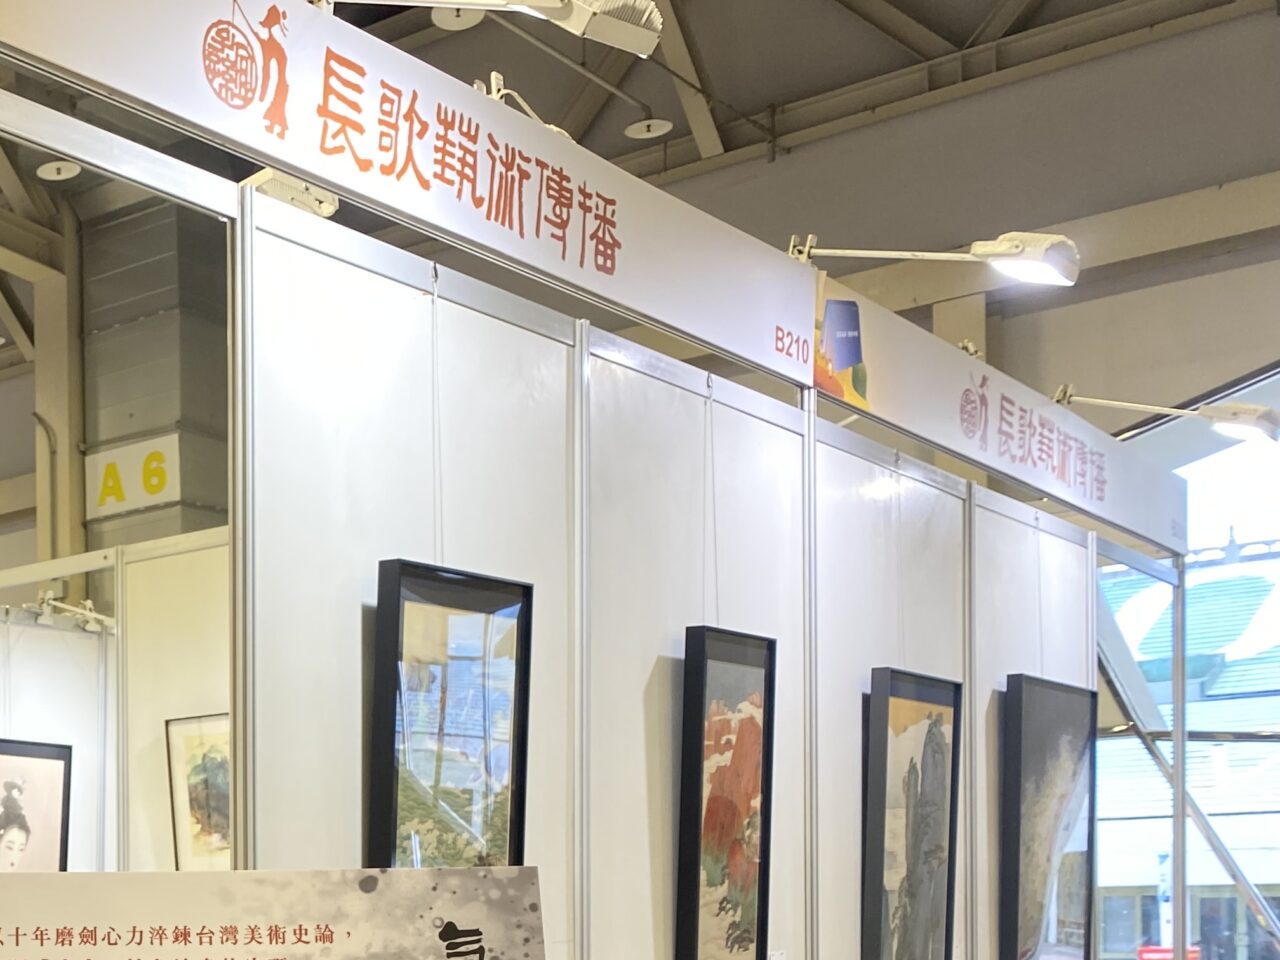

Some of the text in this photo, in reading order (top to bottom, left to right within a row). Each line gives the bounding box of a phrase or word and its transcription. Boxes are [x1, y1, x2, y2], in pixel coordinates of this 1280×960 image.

[774, 325, 810, 365] B210
[98, 450, 168, 507] A 6
